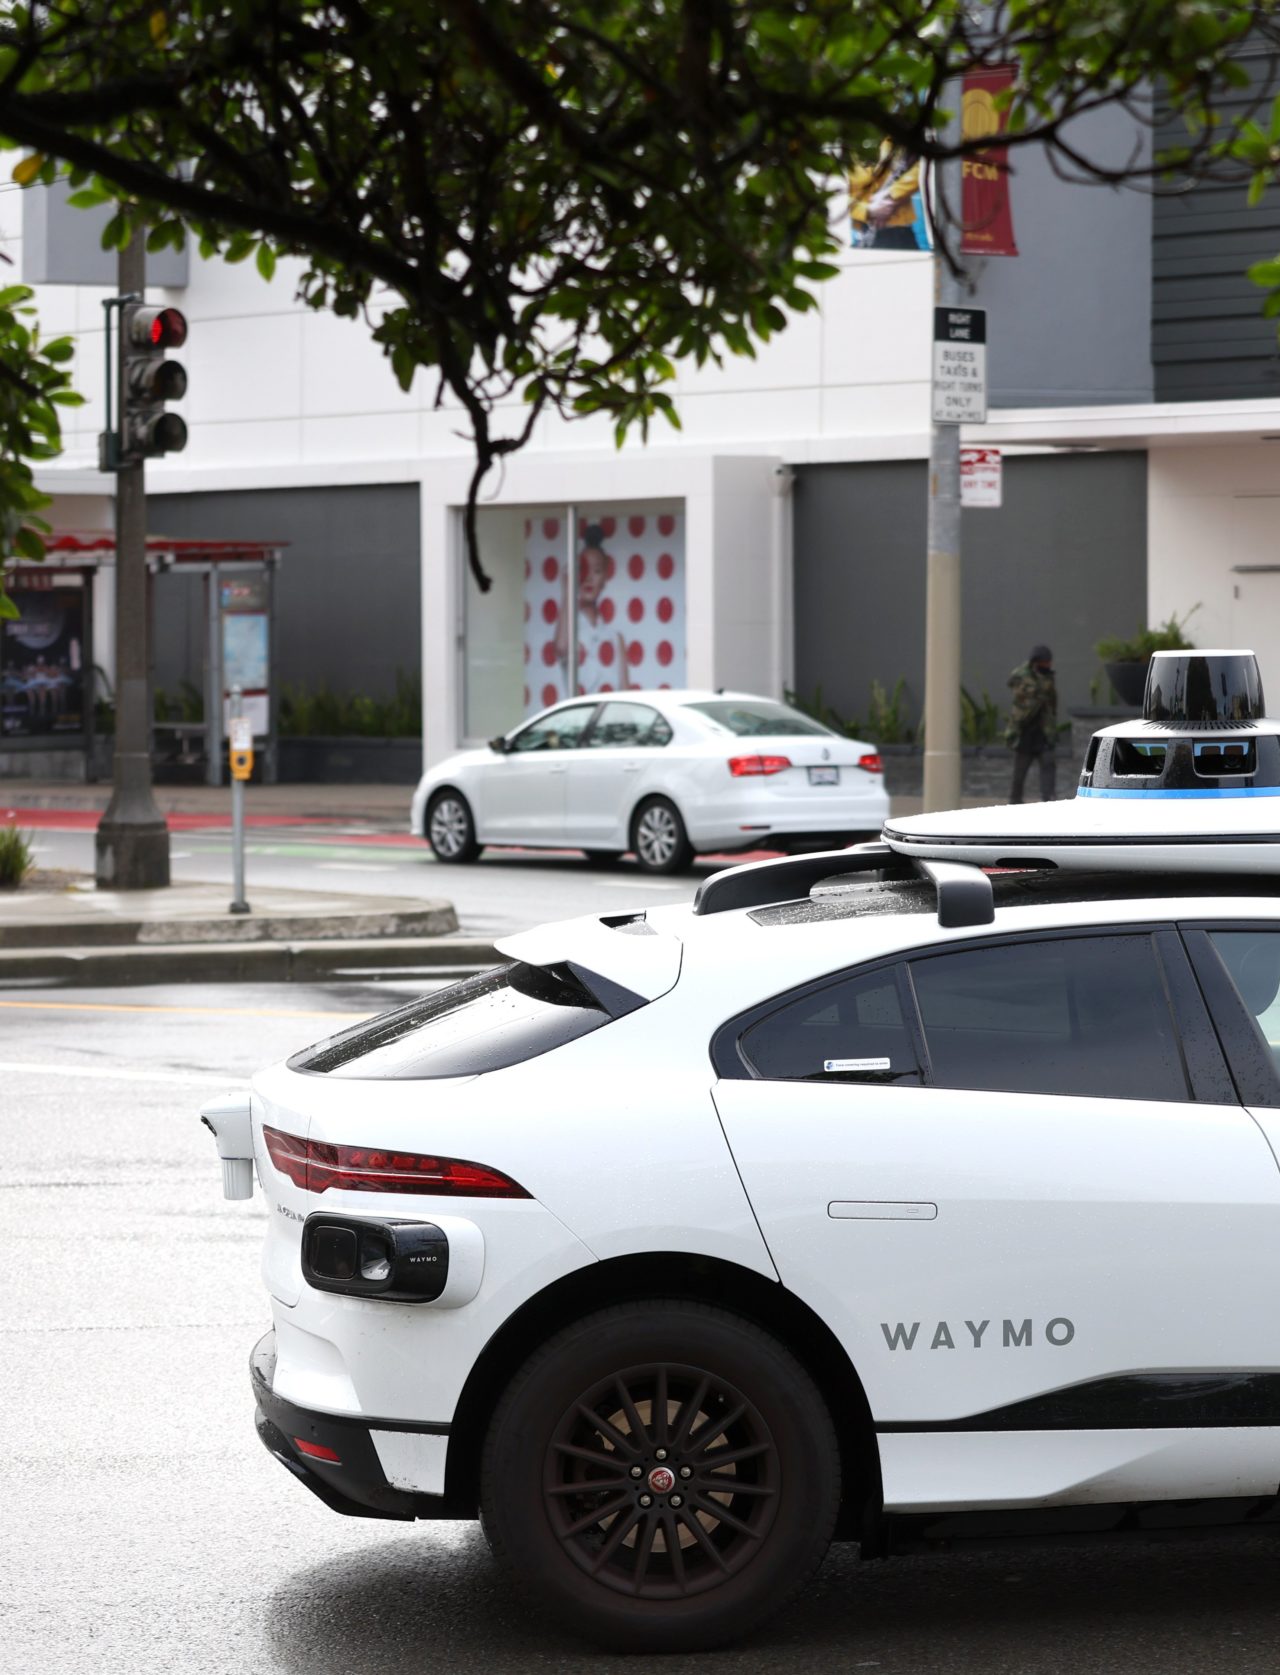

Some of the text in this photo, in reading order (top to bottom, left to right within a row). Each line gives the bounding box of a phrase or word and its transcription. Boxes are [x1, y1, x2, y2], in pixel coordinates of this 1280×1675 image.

[943, 350, 975, 362] BUSES
[945, 396, 972, 408] ONLY
[880, 1317, 1076, 1351] WAYMO
